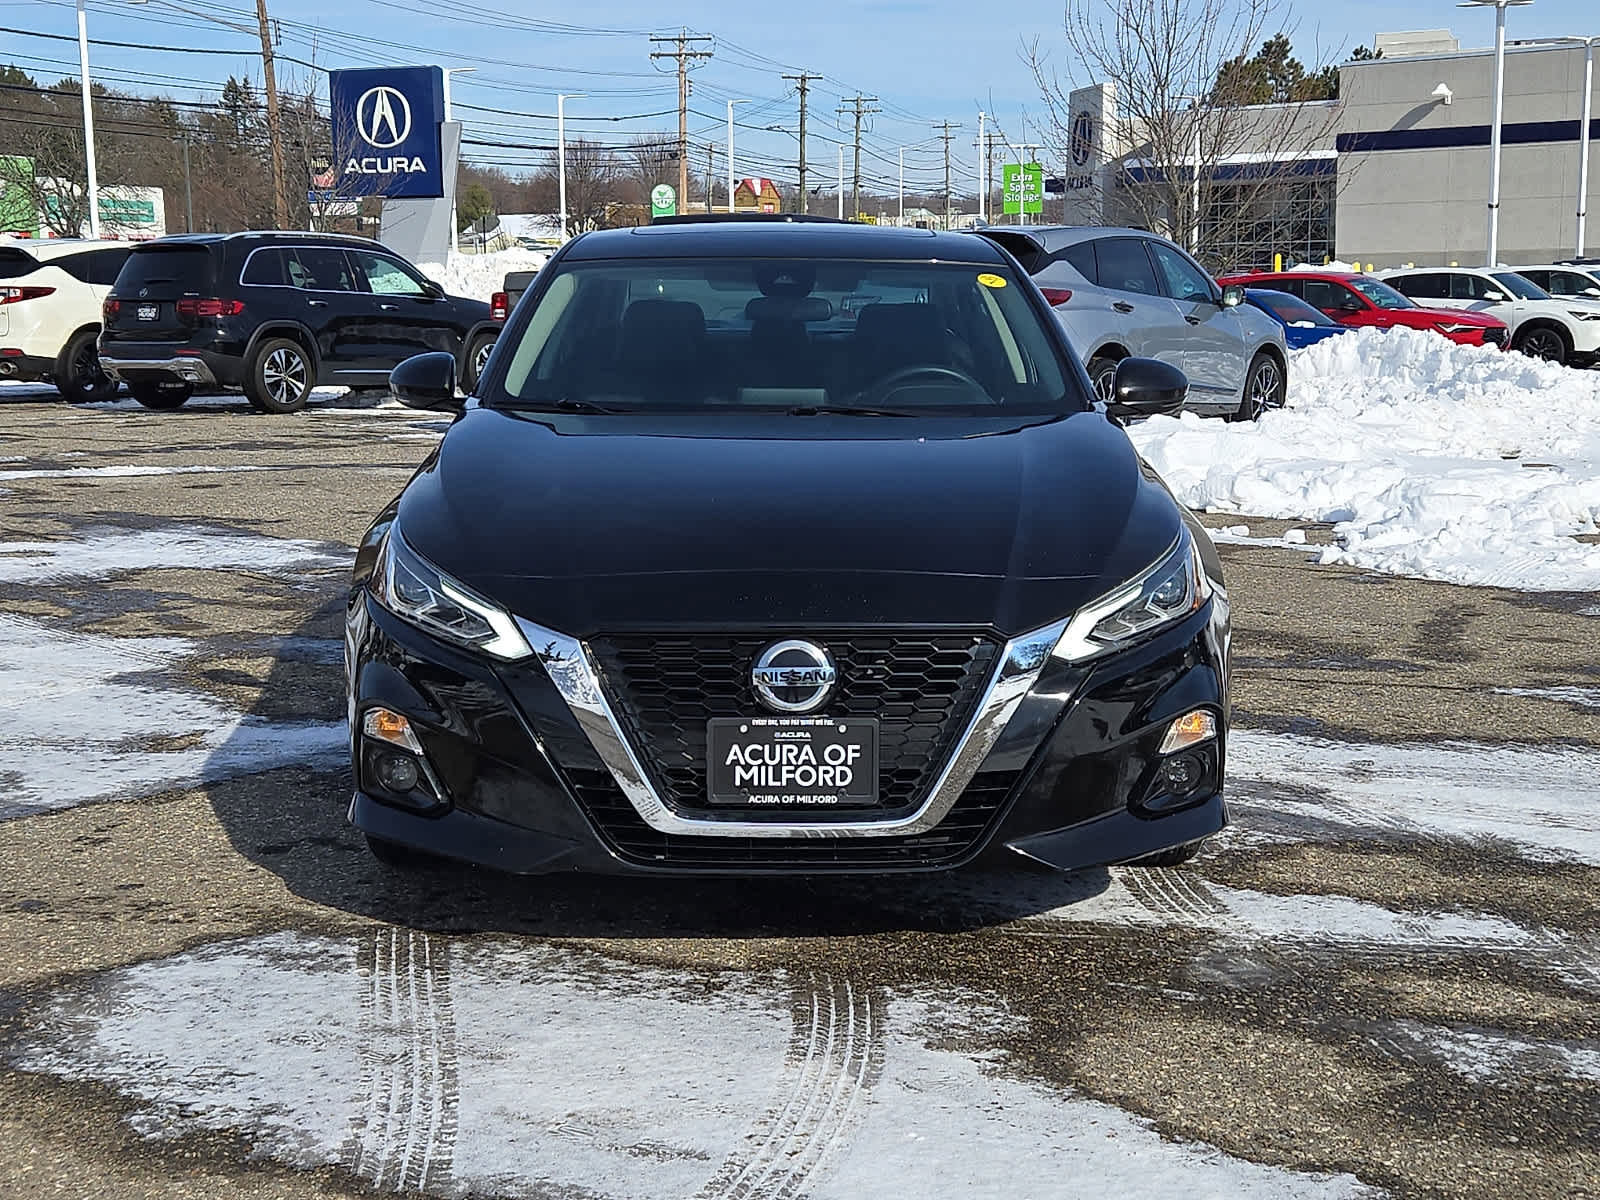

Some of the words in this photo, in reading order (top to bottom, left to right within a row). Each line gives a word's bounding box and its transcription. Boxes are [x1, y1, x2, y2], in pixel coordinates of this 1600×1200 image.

[344, 156, 427, 174] ACURA
[1011, 173, 1033, 182] Exra
[1005, 193, 1040, 202] Stoage
[761, 670, 827, 683] NISSAN
[725, 743, 817, 766] ACURA
[823, 743, 861, 766] OF
[734, 765, 853, 787] MILFORD
[748, 795, 780, 804] ACURA
[781, 795, 795, 804] OF
[796, 795, 838, 804] MILFORD
